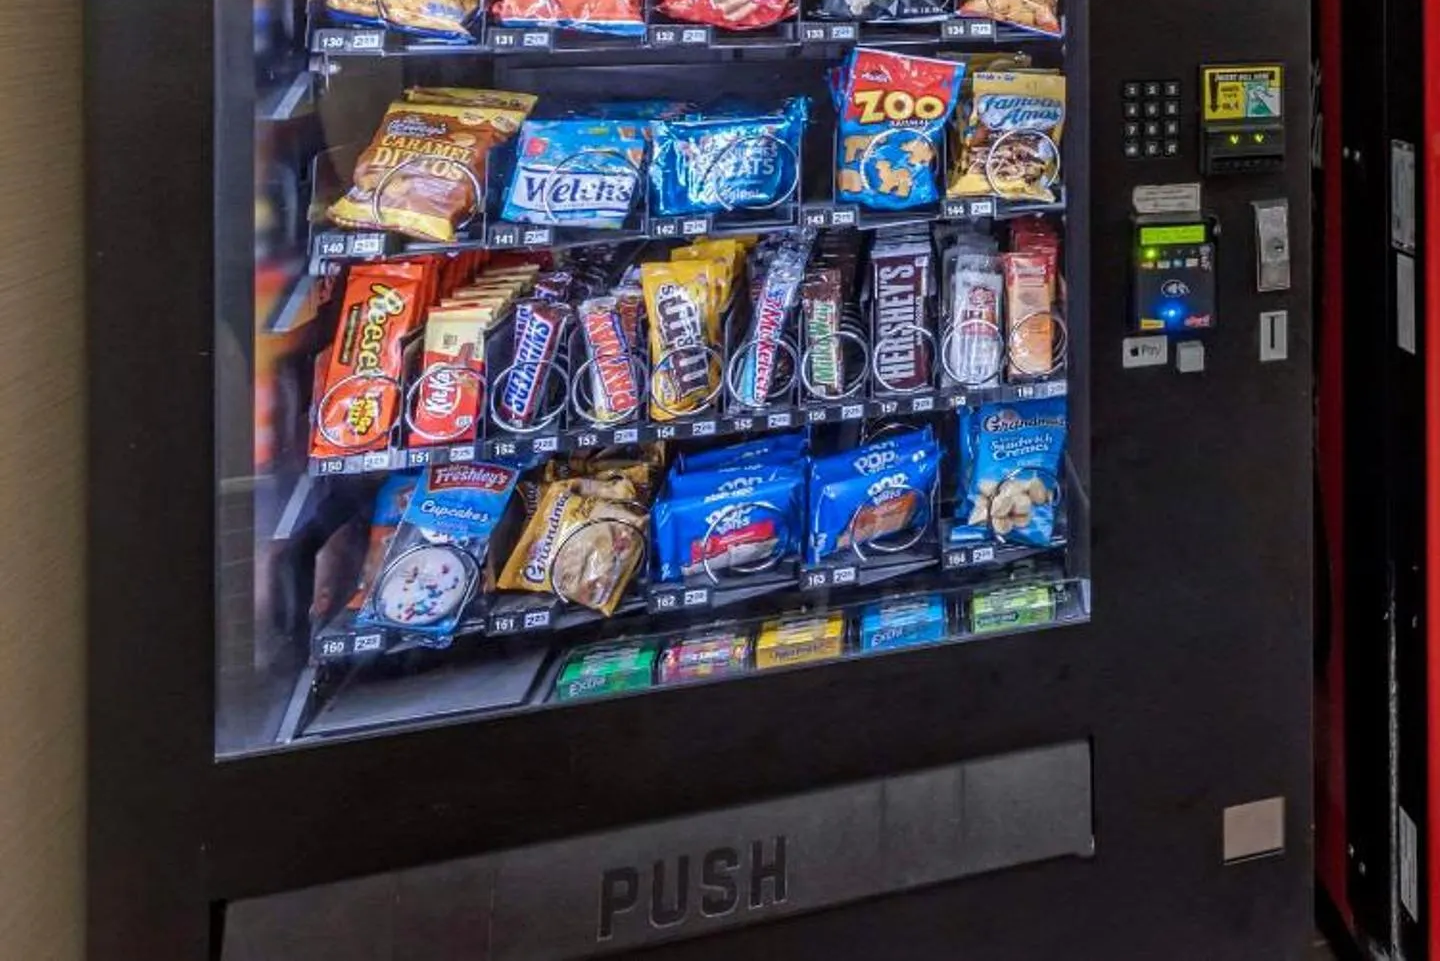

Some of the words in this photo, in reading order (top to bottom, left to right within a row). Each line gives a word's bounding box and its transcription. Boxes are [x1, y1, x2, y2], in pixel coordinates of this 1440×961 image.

[321, 36, 344, 48] 130
[494, 34, 515, 46] 131
[852, 88, 946, 124] ZOO
[998, 106, 1062, 127] Amos
[380, 133, 473, 164] CARAMEL
[656, 224, 675, 236] 142
[494, 233, 515, 245] 141
[322, 241, 345, 254] 140
[878, 264, 916, 381] HERSHEY'S
[411, 453, 431, 465] 151
[434, 467, 509, 489] Freshley's
[420, 499, 490, 523] Cupcakes
[495, 618, 516, 630] 161
[322, 641, 346, 655] 160
[597, 835, 789, 943] PUSH
